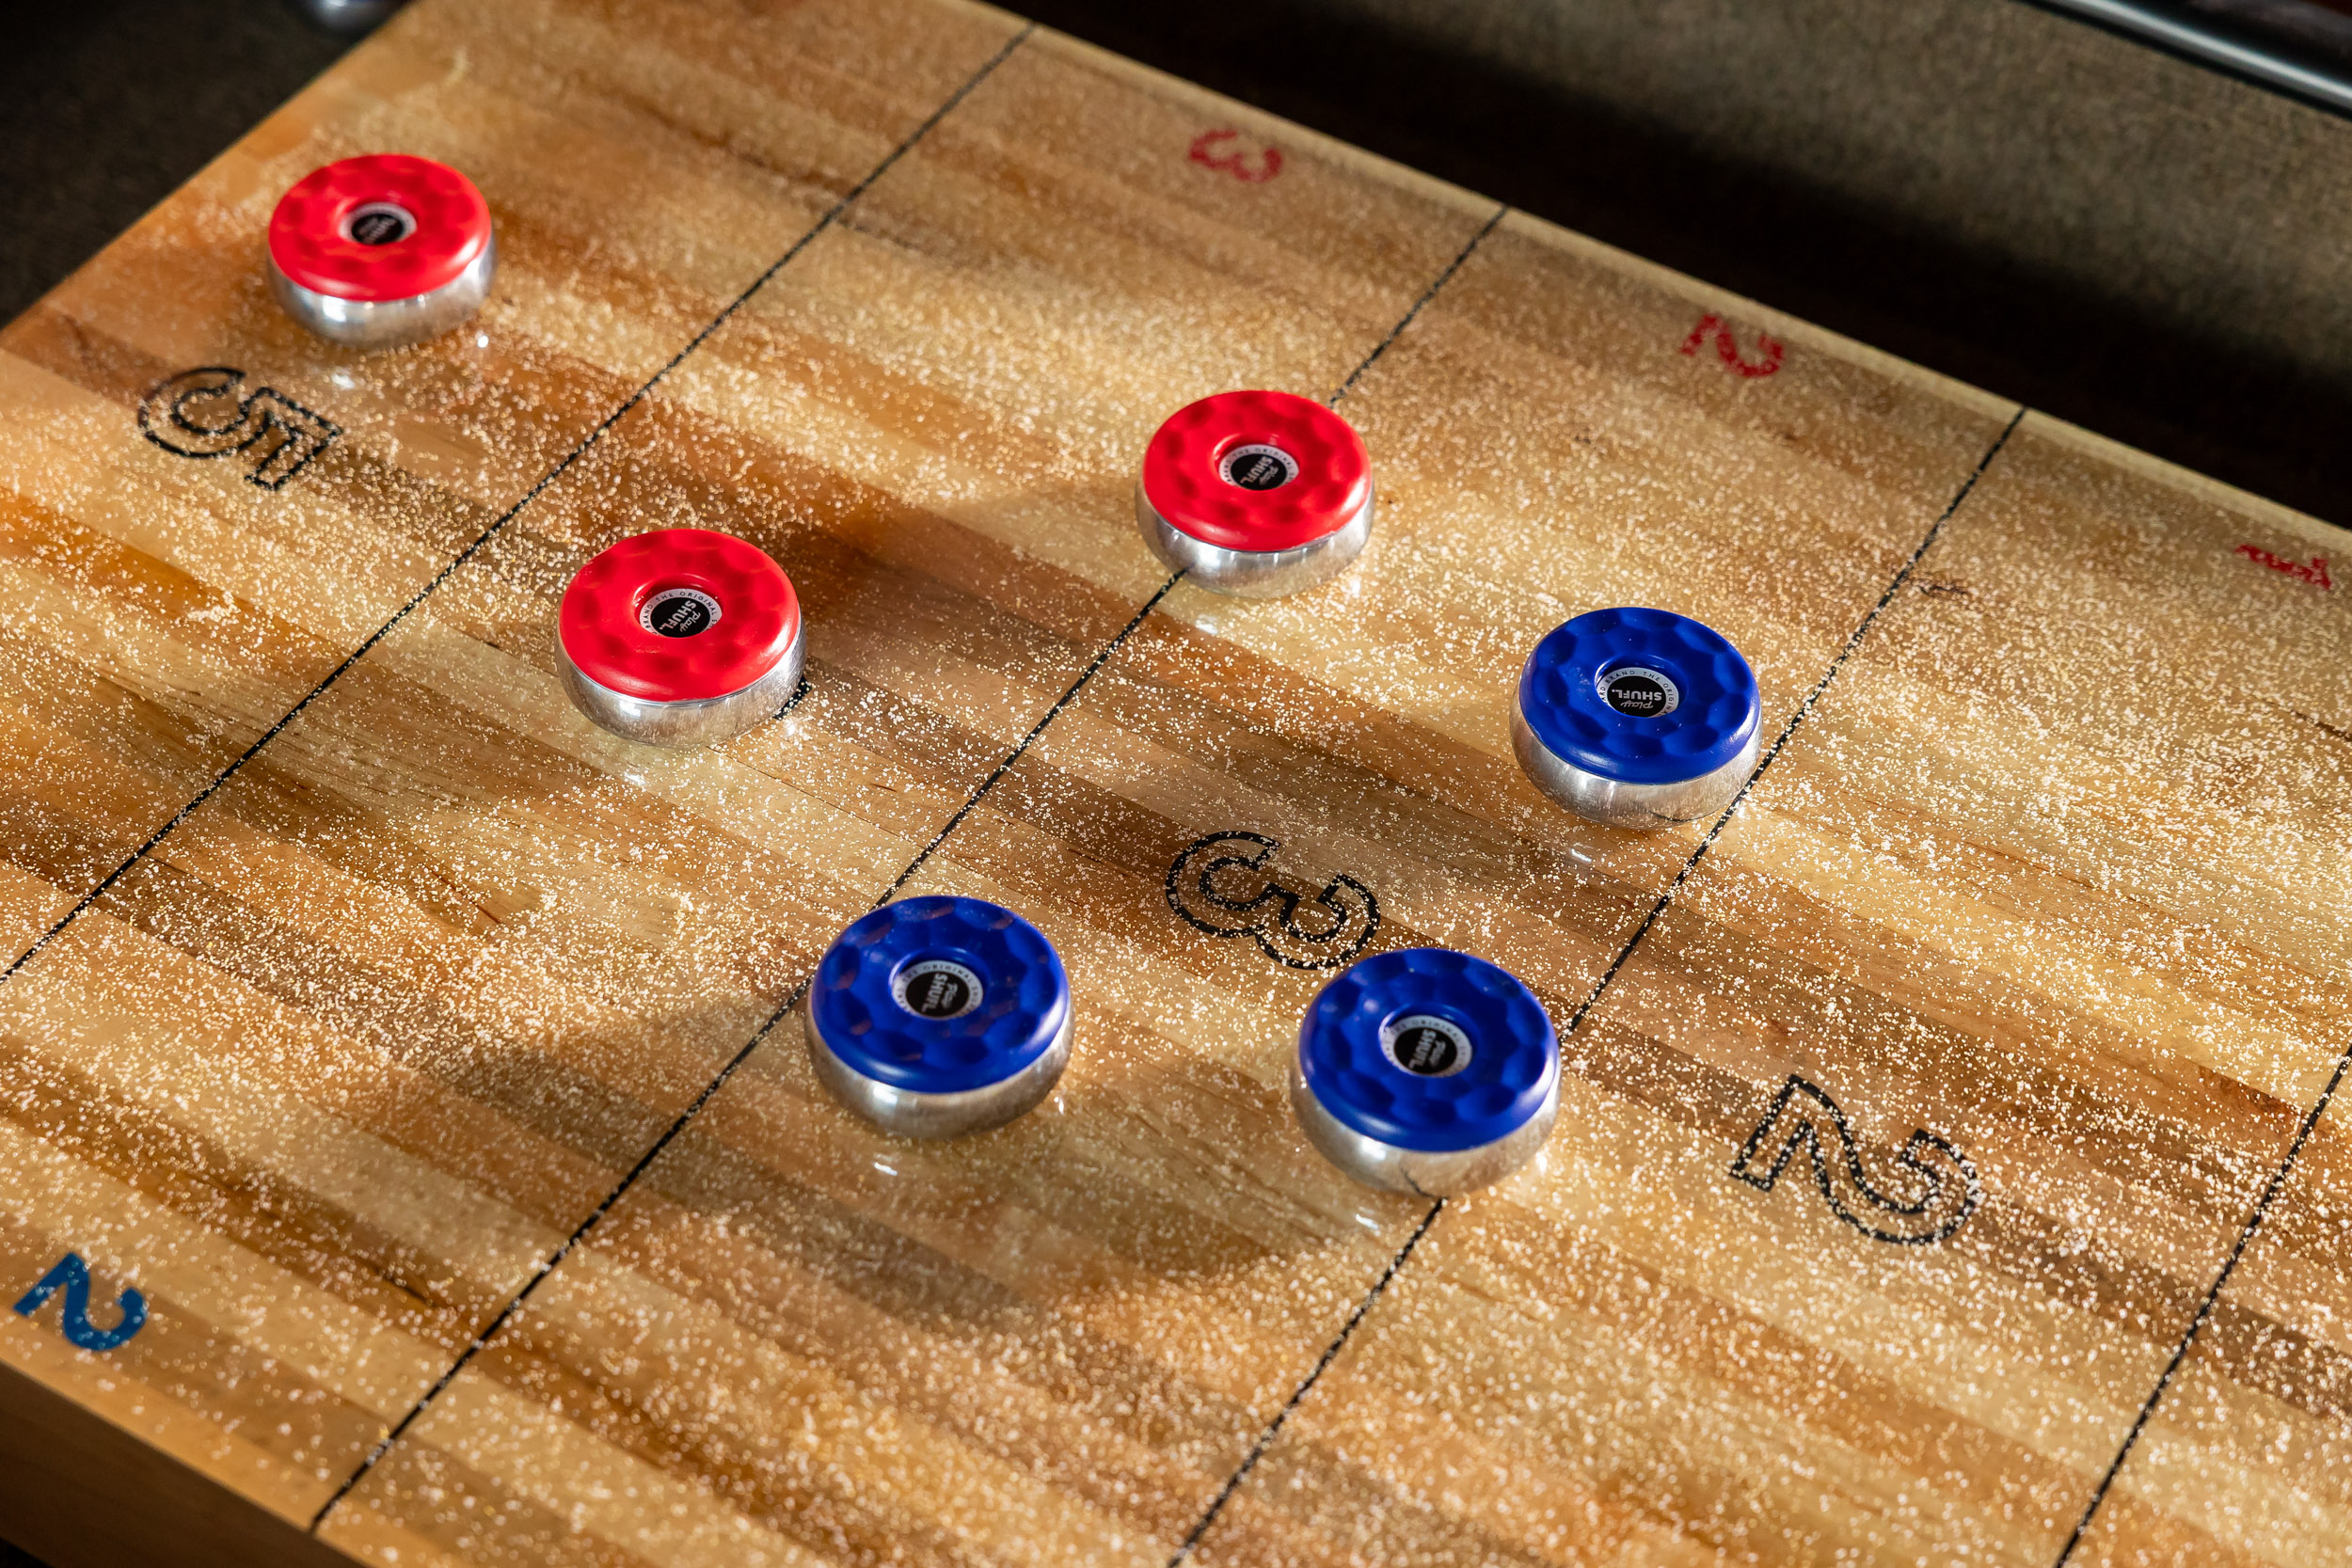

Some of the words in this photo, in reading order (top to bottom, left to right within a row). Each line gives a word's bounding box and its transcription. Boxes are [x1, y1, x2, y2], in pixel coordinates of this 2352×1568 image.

[1189, 130, 1282, 182] 3
[1679, 312, 1785, 378] 2
[138, 366, 342, 490] 5
[679, 591, 718, 616] ORIGINAL
[679, 610, 701, 632] Play
[1605, 670, 1635, 685] BRAND
[1611, 689, 1662, 702] SHUFL.
[1620, 700, 1654, 710] Play
[1165, 831, 1380, 970] 3
[1729, 1073, 1978, 1245] 2
[13, 1252, 148, 1352] 2
